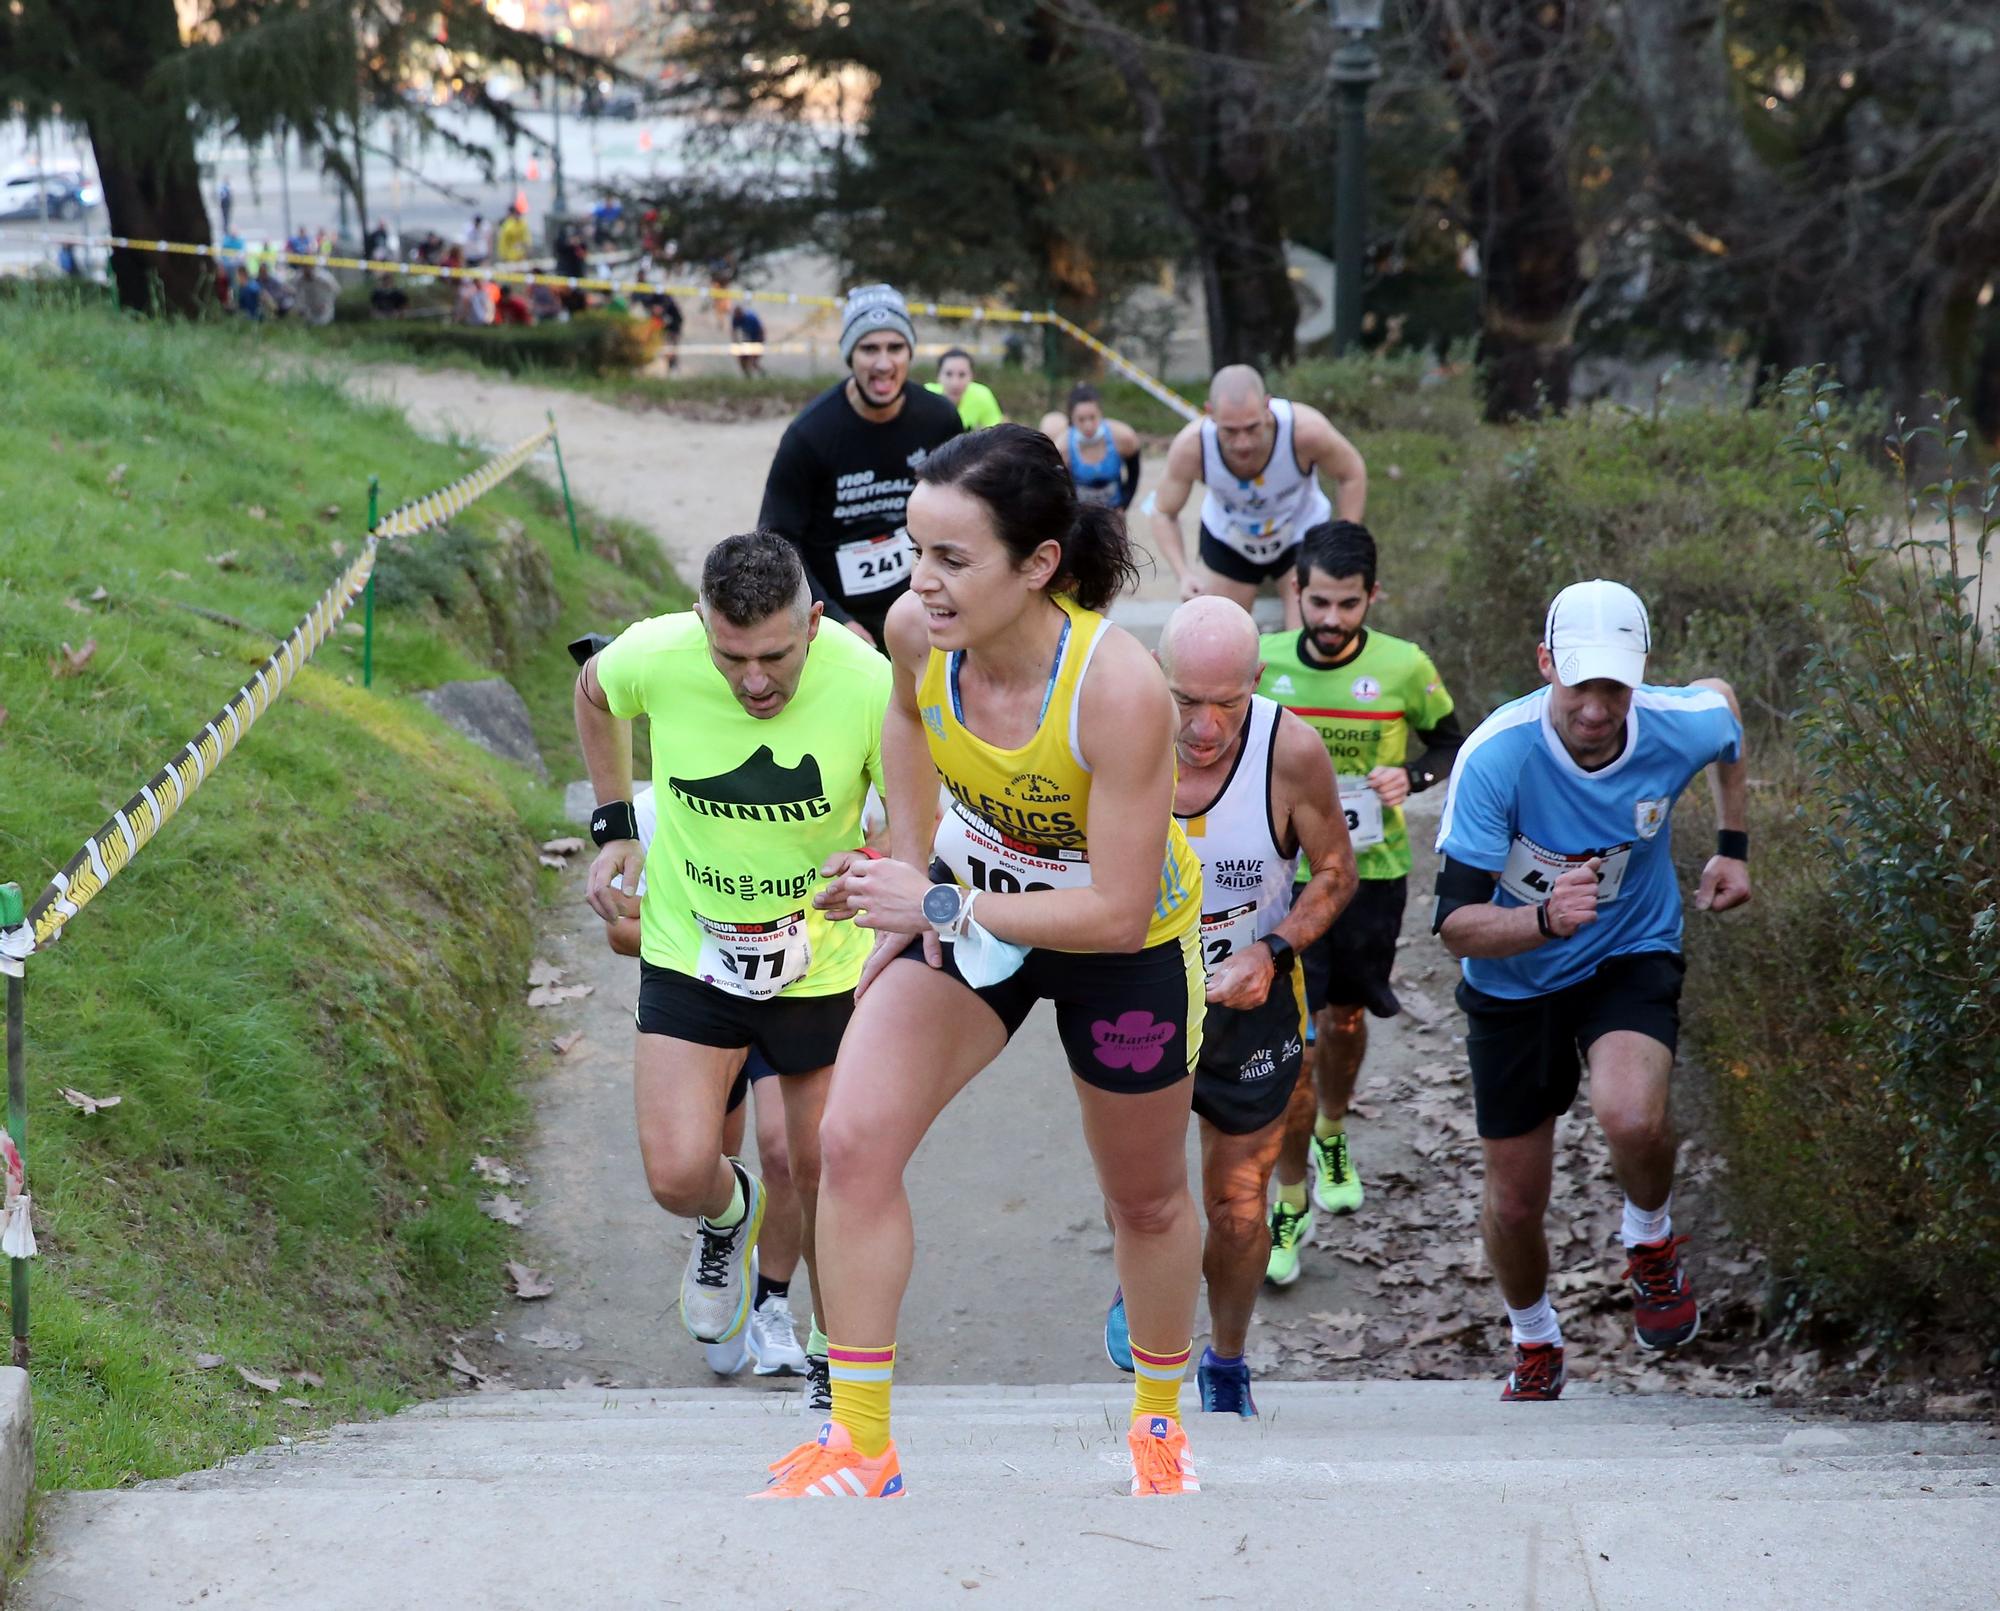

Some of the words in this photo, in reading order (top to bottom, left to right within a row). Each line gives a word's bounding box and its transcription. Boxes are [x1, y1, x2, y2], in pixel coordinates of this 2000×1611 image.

[837, 470, 875, 490] VIGO
[859, 551, 902, 579] 241
[965, 829, 1001, 854] SUBIDA
[1003, 849, 1018, 861] AO
[1020, 855, 1068, 873] CASTRO
[999, 860, 1026, 875] ROCIO
[1215, 860, 1264, 872] SHAVE
[740, 874, 758, 901] que
[760, 867, 817, 898] auga
[1215, 874, 1263, 888] SAILOR
[1201, 920, 1235, 932] CASTRO
[751, 931, 784, 943] CASTRO
[1240, 1061, 1275, 1080] SAILOR
